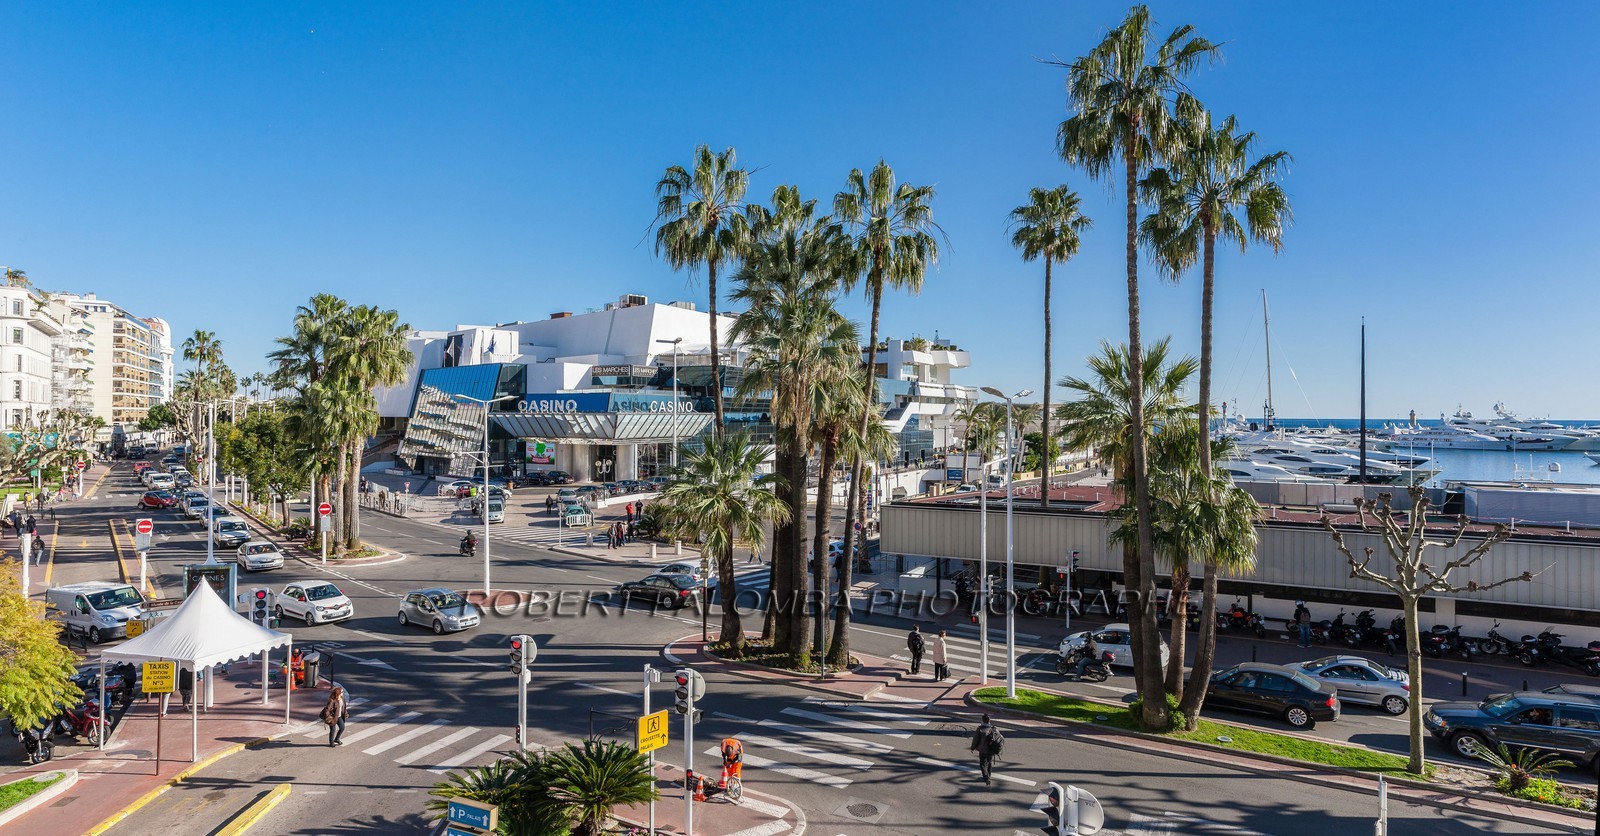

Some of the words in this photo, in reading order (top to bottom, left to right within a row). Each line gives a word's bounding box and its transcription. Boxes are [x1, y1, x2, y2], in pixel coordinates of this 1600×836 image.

[517, 399, 577, 412] CASINO
[650, 400, 693, 413] CASNO
[640, 734, 660, 743] CROISETTE
